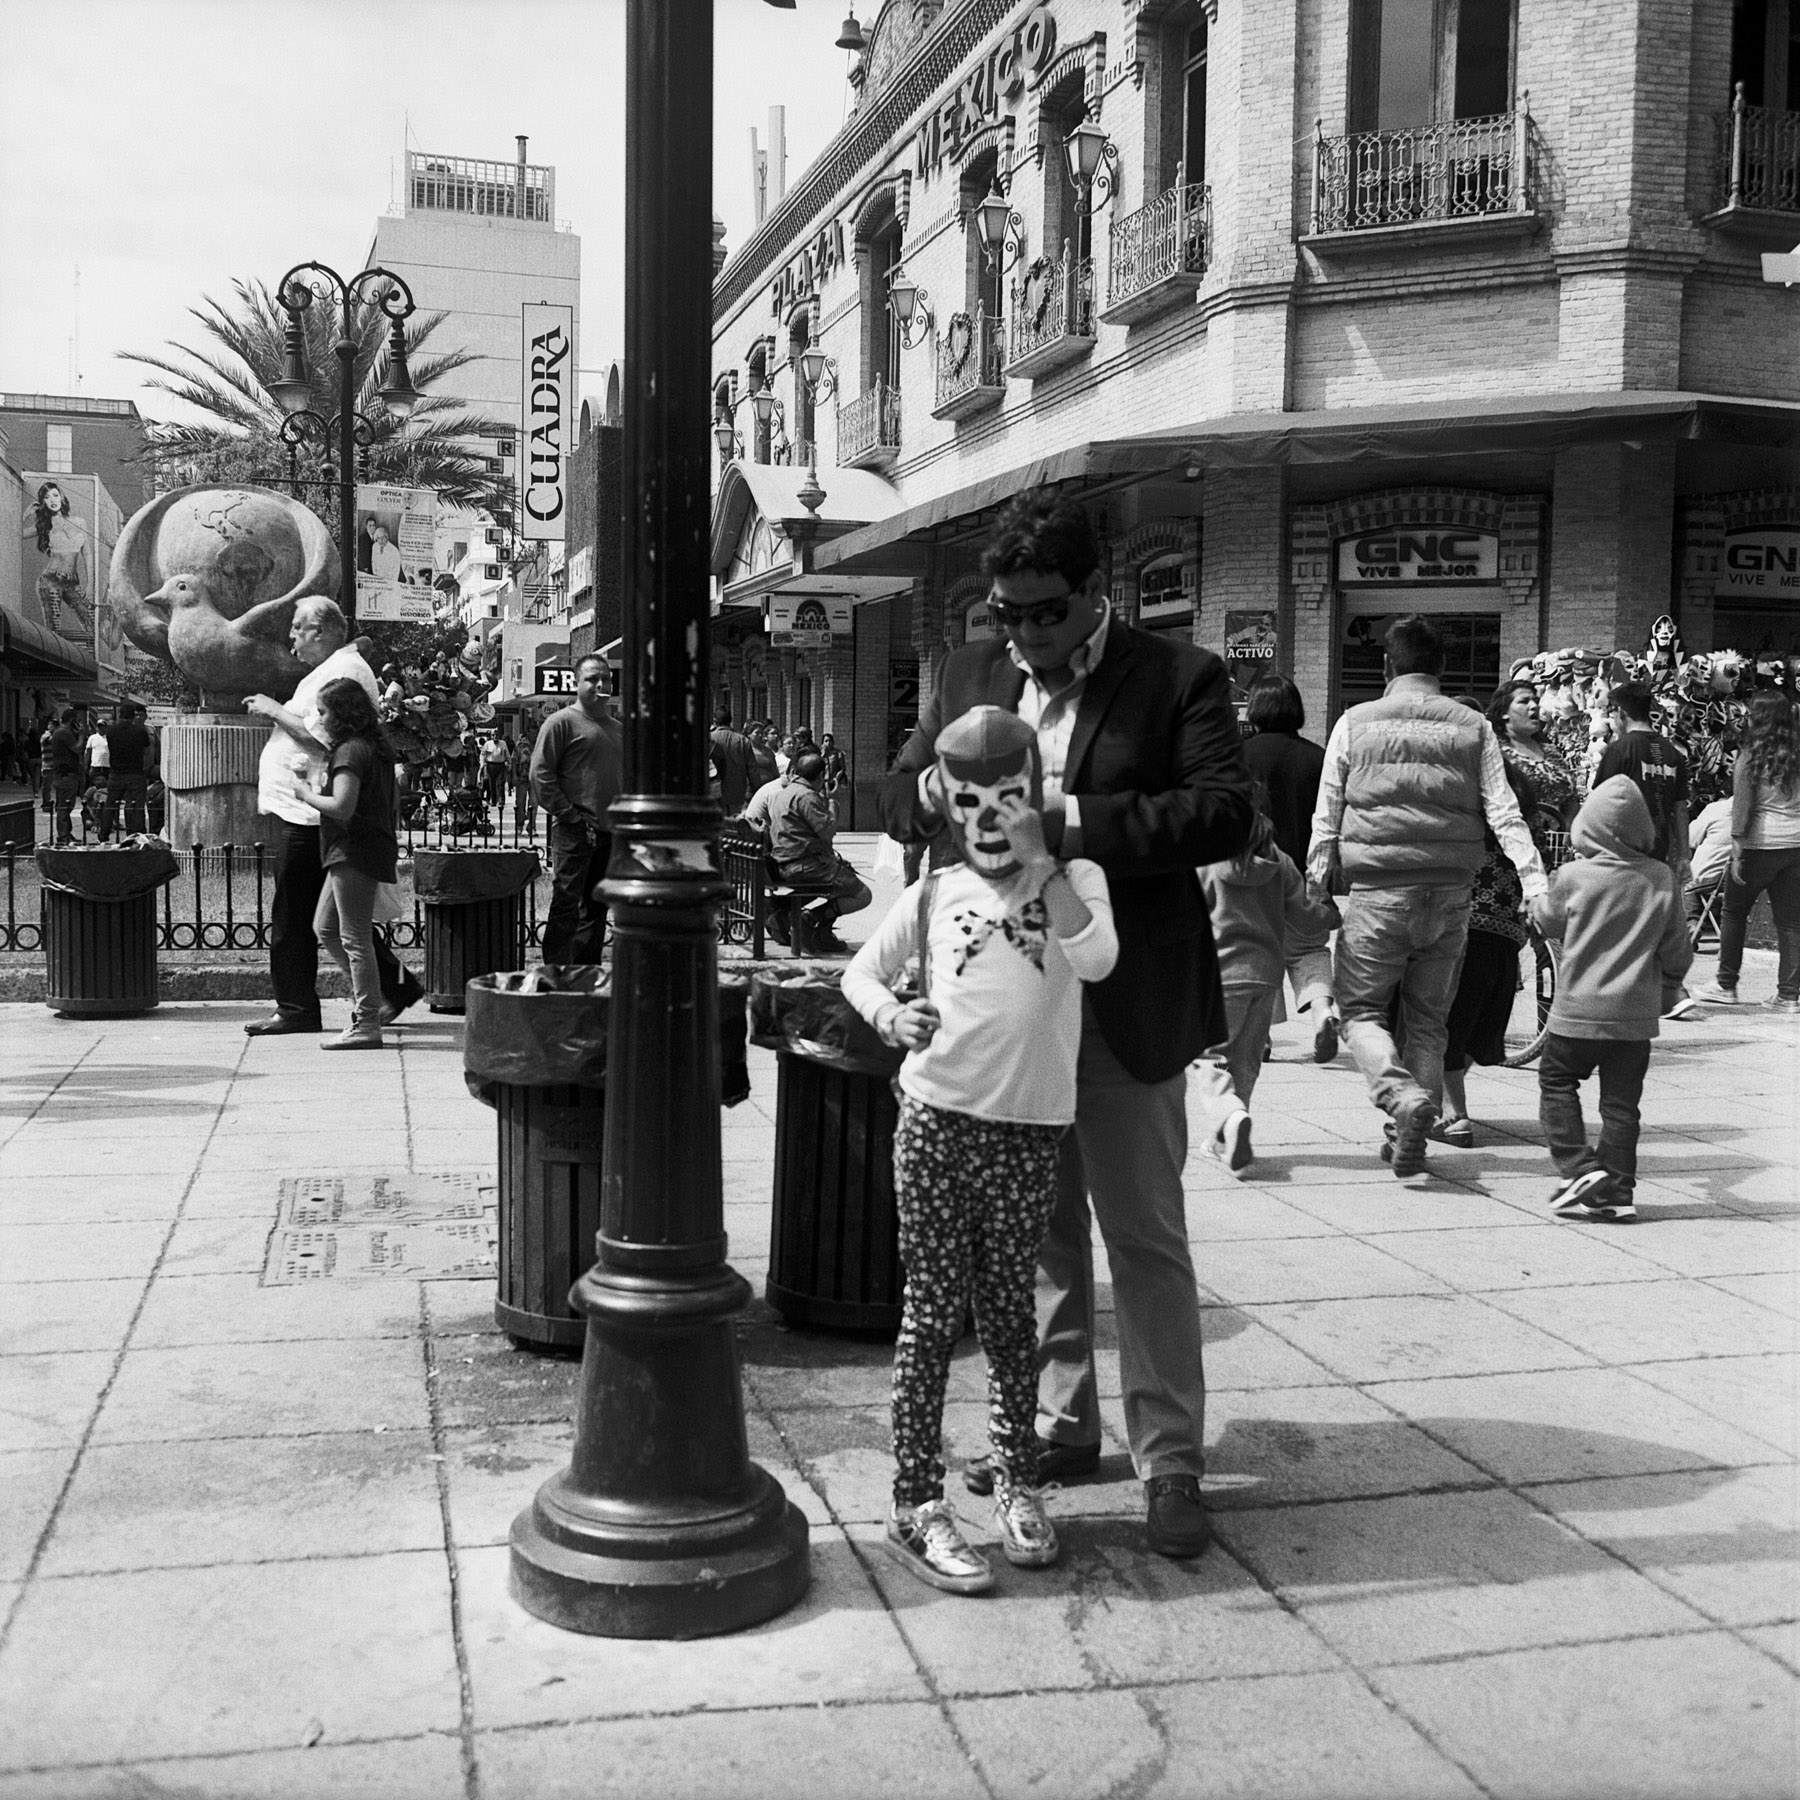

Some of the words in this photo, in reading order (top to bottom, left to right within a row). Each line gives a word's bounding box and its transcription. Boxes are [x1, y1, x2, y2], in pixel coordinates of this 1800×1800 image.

[916, 7, 1056, 180] MEXICO
[771, 218, 845, 317] PLAZA
[525, 325, 570, 521] CUADRA
[380, 490, 402, 498] OPTICA
[1355, 536, 1480, 563] GNC
[1727, 544, 1800, 572] GN
[1356, 566, 1401, 578] VIVE
[1417, 564, 1478, 577] MEJOR
[1728, 573, 1766, 586] VIVE
[796, 615, 828, 623] PLAZA
[1227, 648, 1274, 659] ACTIVO
